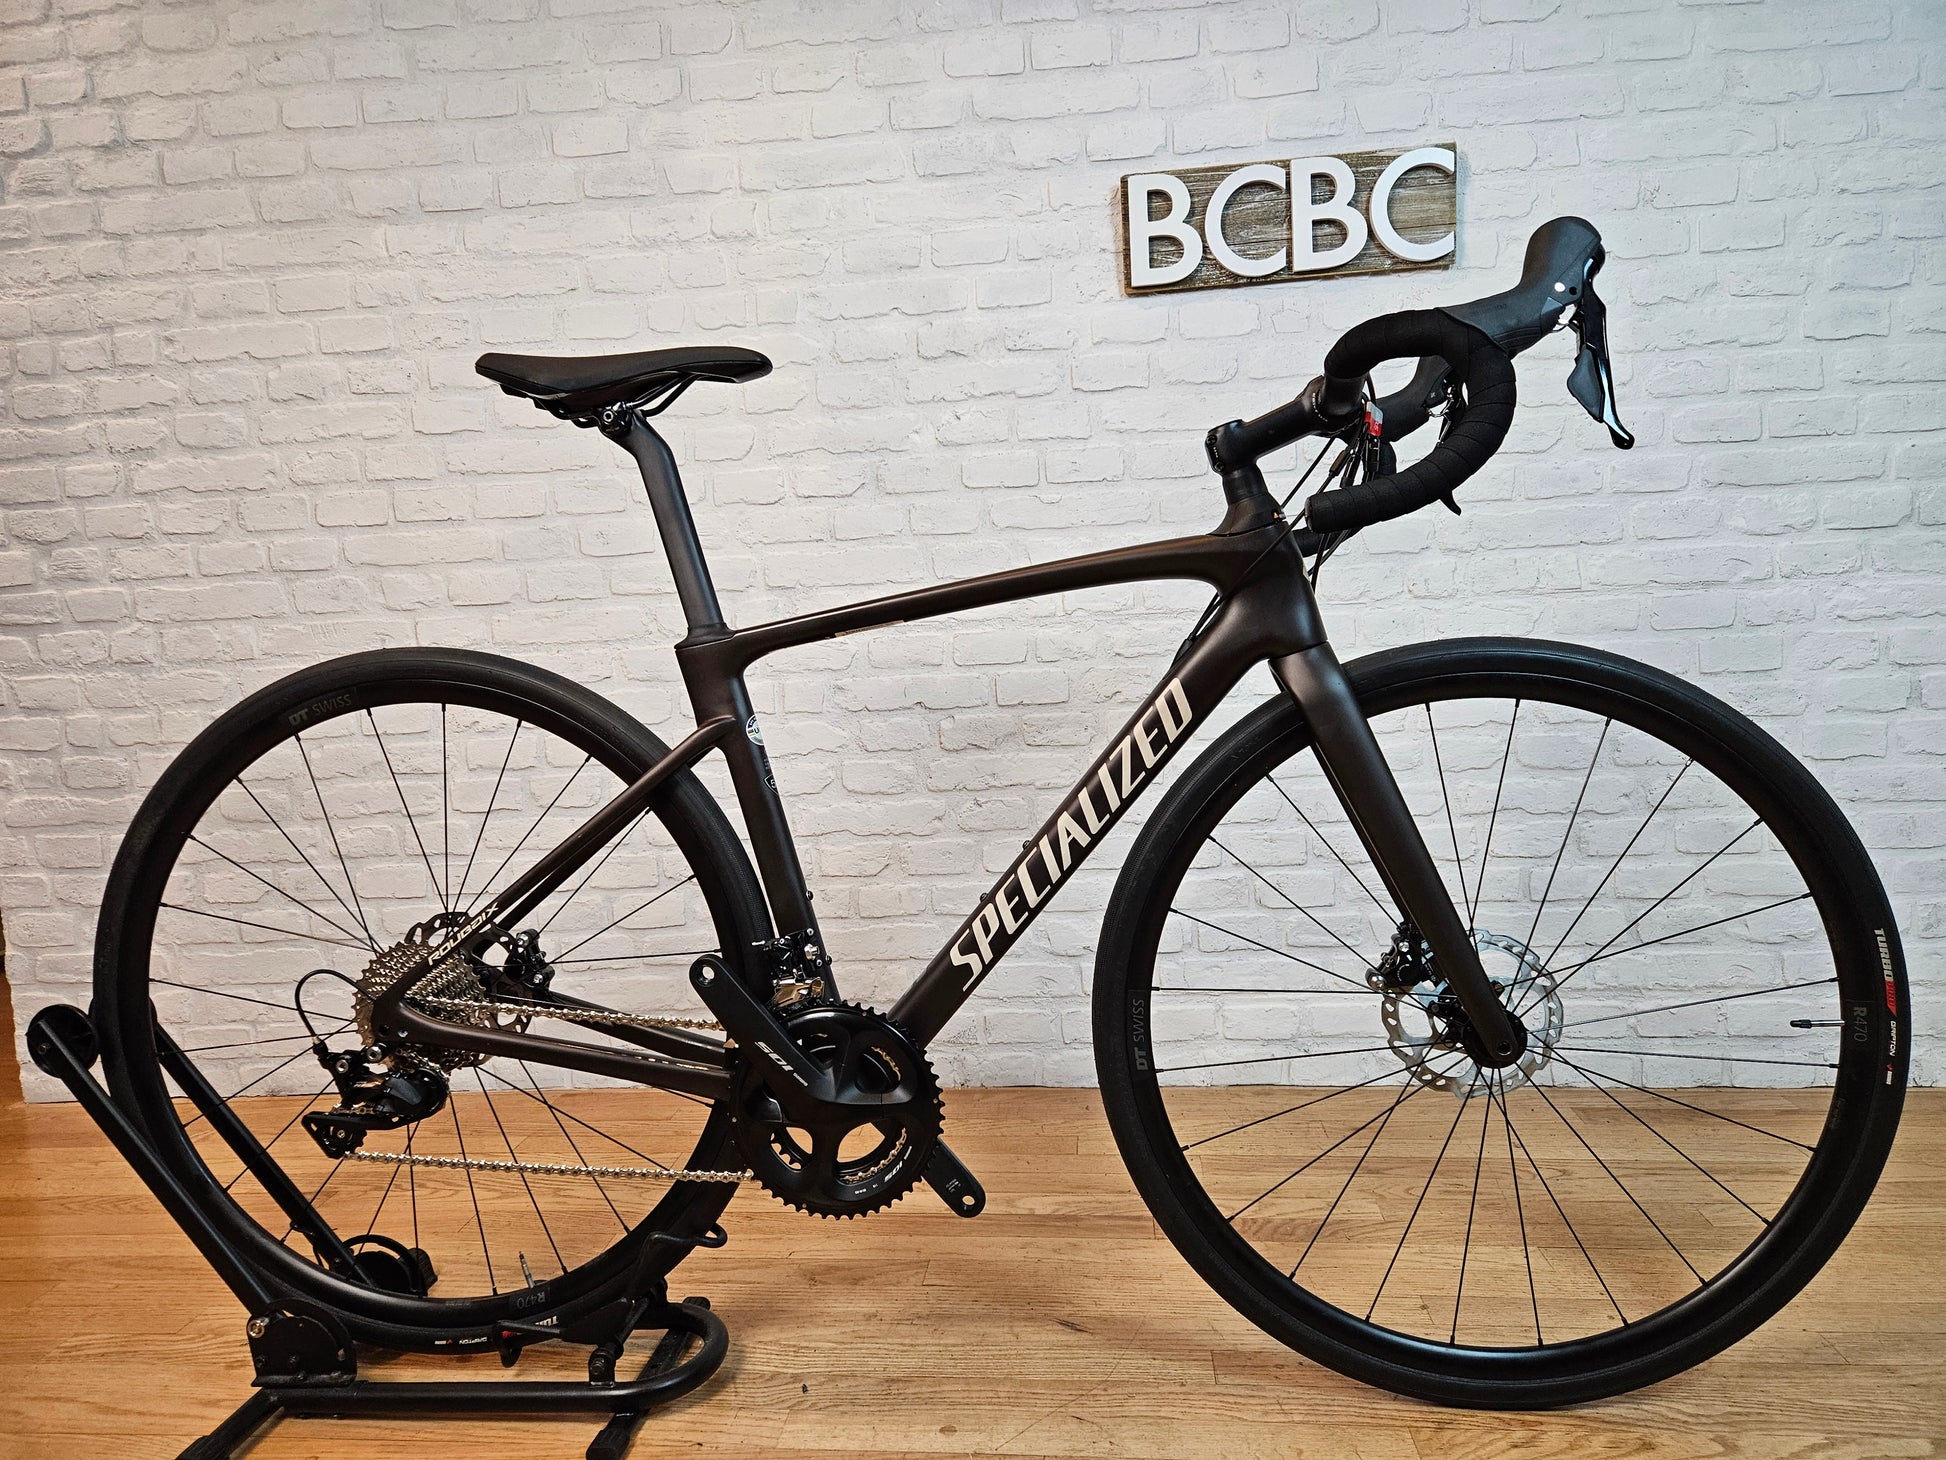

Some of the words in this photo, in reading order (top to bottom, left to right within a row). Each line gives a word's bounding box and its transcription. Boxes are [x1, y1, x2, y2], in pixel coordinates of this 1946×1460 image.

[1127, 148, 1455, 287] BCBC
[288, 708, 308, 726] DT
[312, 694, 353, 716] SWISS
[950, 677, 1193, 992] SPECIALIZED
[428, 902, 499, 966] ROUBAIX
[1874, 928, 1894, 981] TURBO
[1132, 999, 1145, 1042] SWISS
[1853, 1006, 1868, 1042] R470
[1134, 1047, 1149, 1071] DT
[516, 1292, 546, 1309] R470
